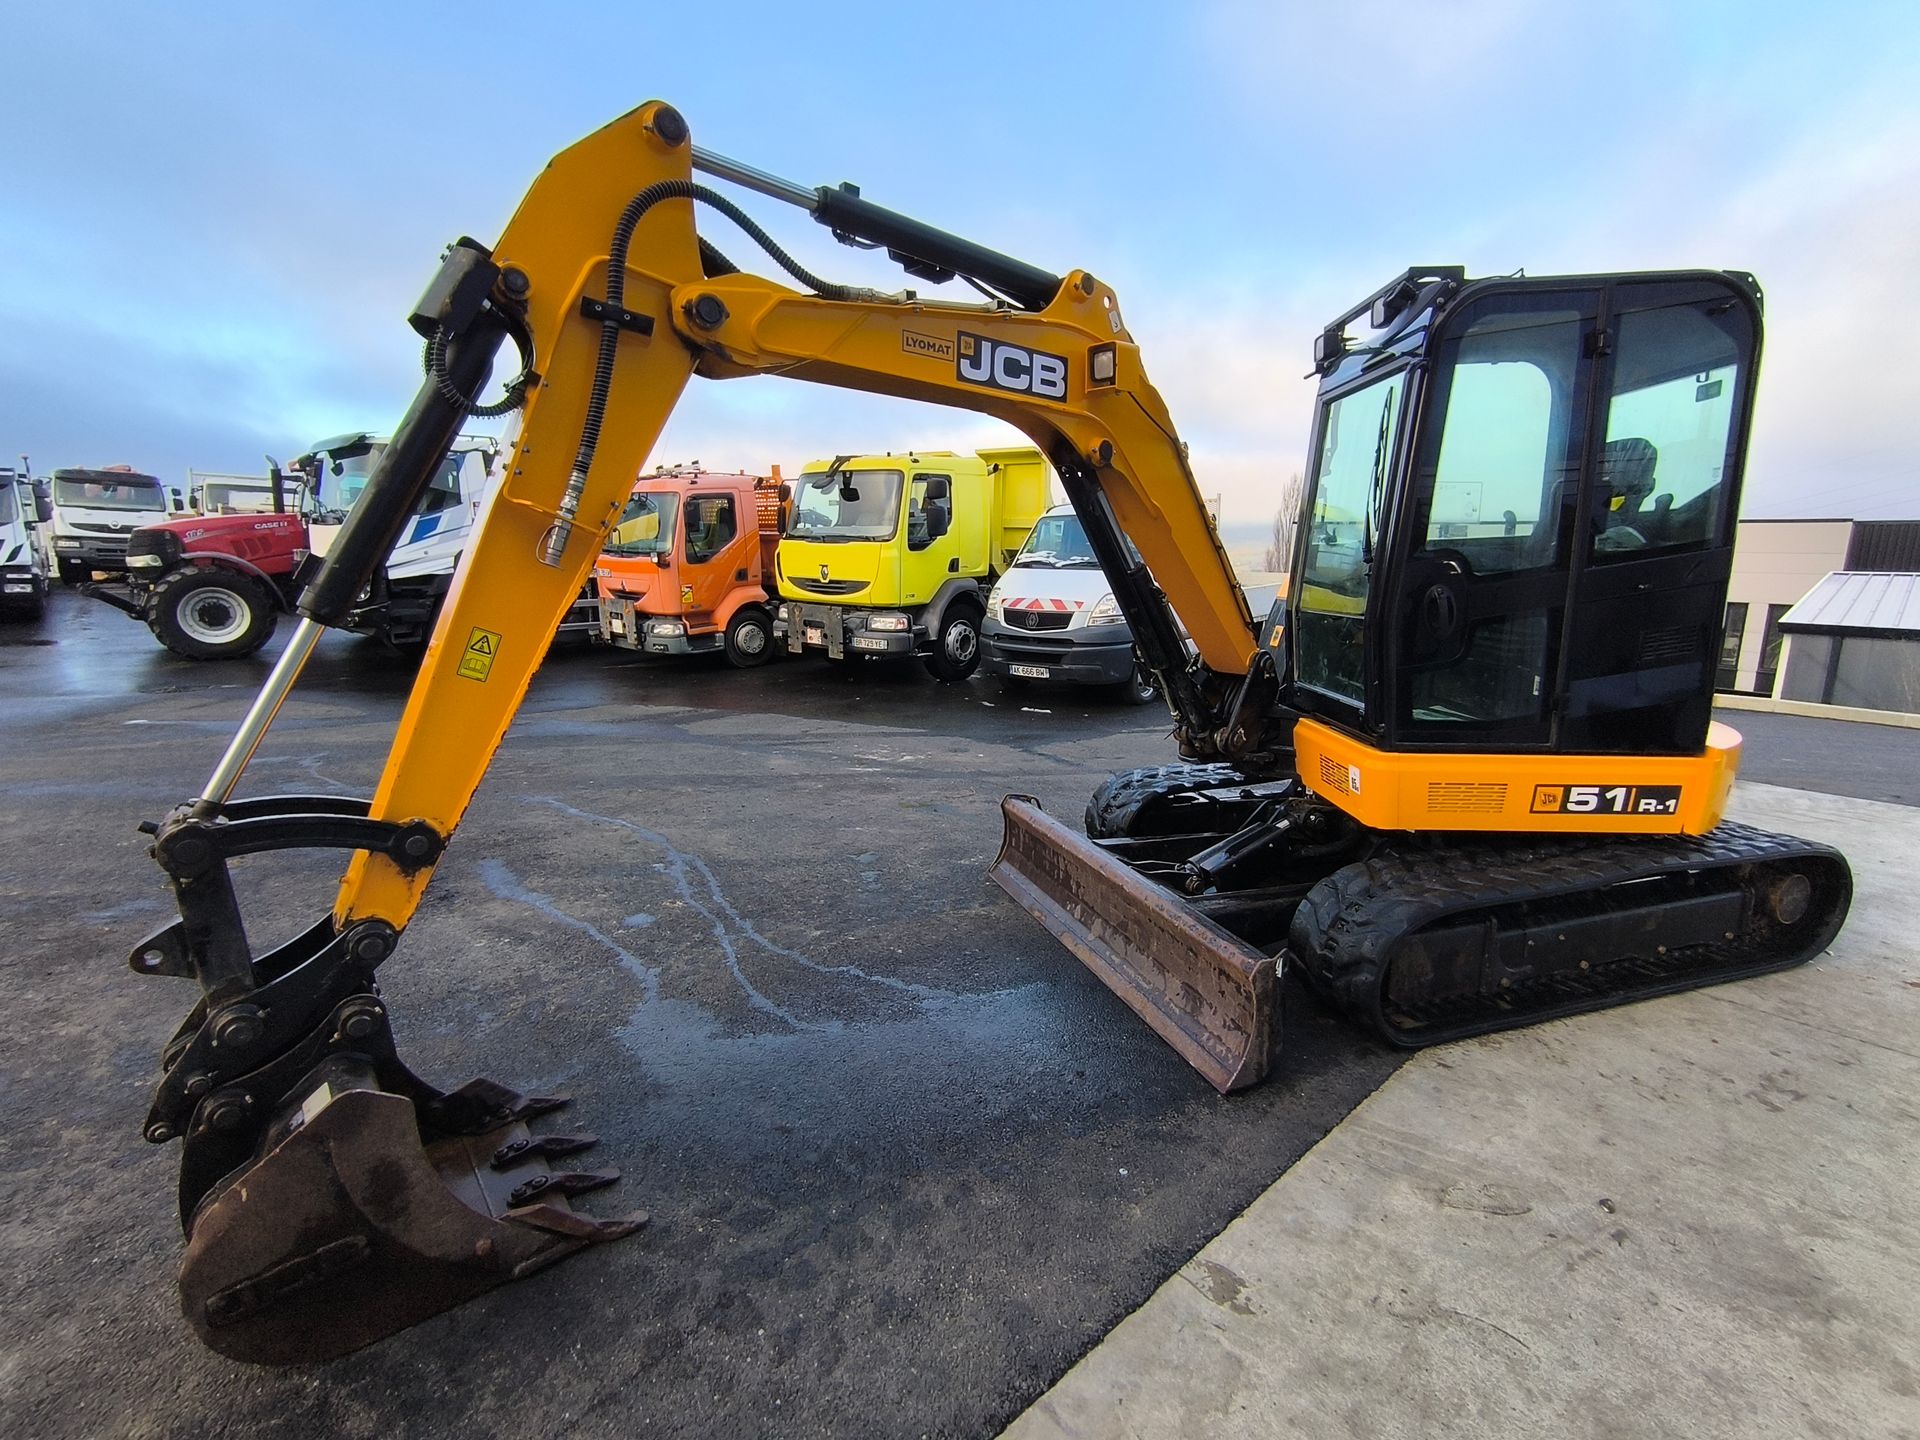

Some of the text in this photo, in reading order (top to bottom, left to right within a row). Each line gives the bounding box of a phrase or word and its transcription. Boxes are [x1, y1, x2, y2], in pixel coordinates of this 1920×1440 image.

[905, 336, 952, 356] LYOMAT
[960, 340, 1066, 398] JCB
[254, 521, 279, 529] CASE
[1022, 667, 1034, 676] 666
[1541, 792, 1557, 806] JCB
[1566, 786, 1677, 813] 51 R-1
